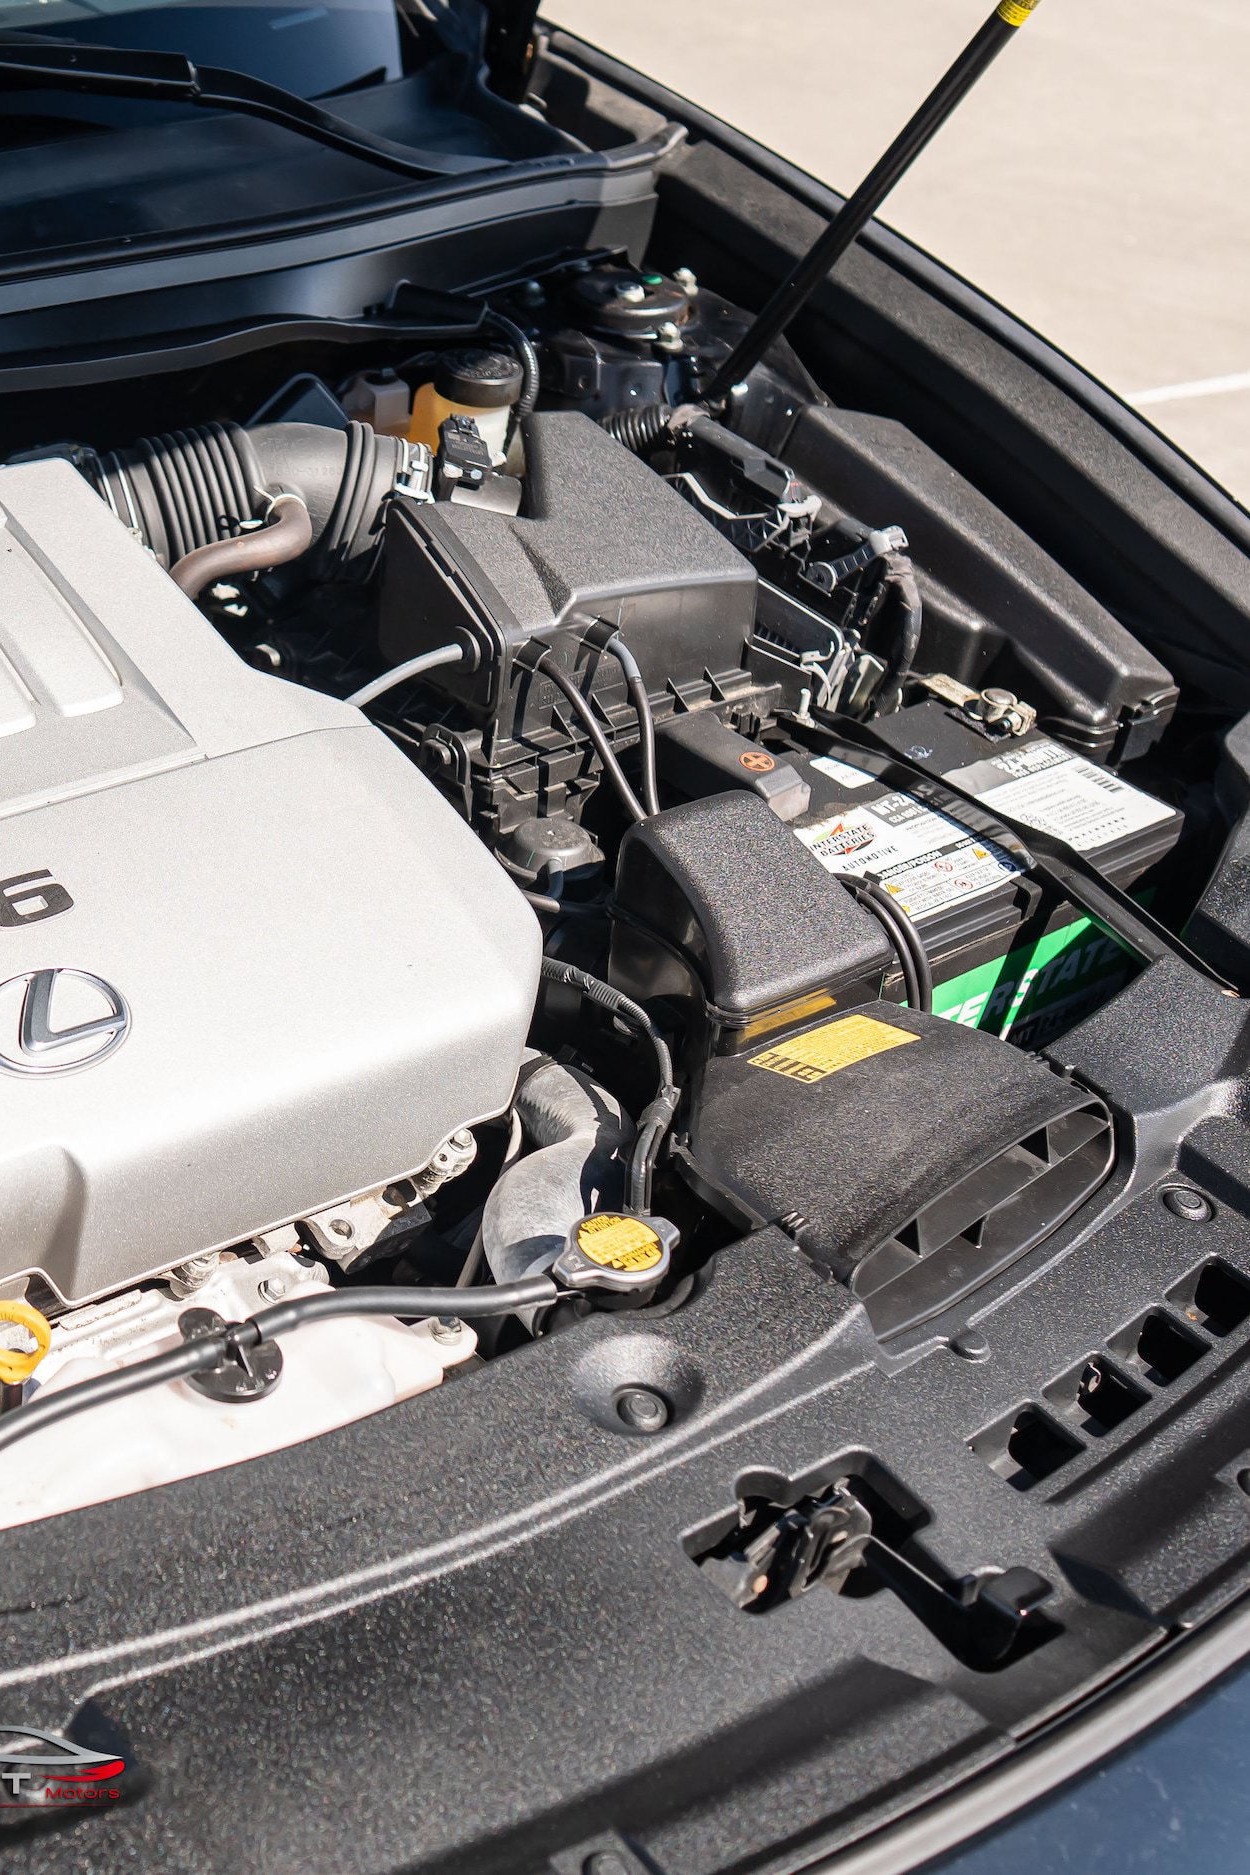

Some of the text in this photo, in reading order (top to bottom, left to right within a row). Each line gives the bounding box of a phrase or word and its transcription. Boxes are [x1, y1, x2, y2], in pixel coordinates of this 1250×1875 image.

[809, 823, 871, 852] INTERSTATE
[820, 832, 876, 857] BATTERIES
[842, 845, 899, 872] AUTOMOTIVE
